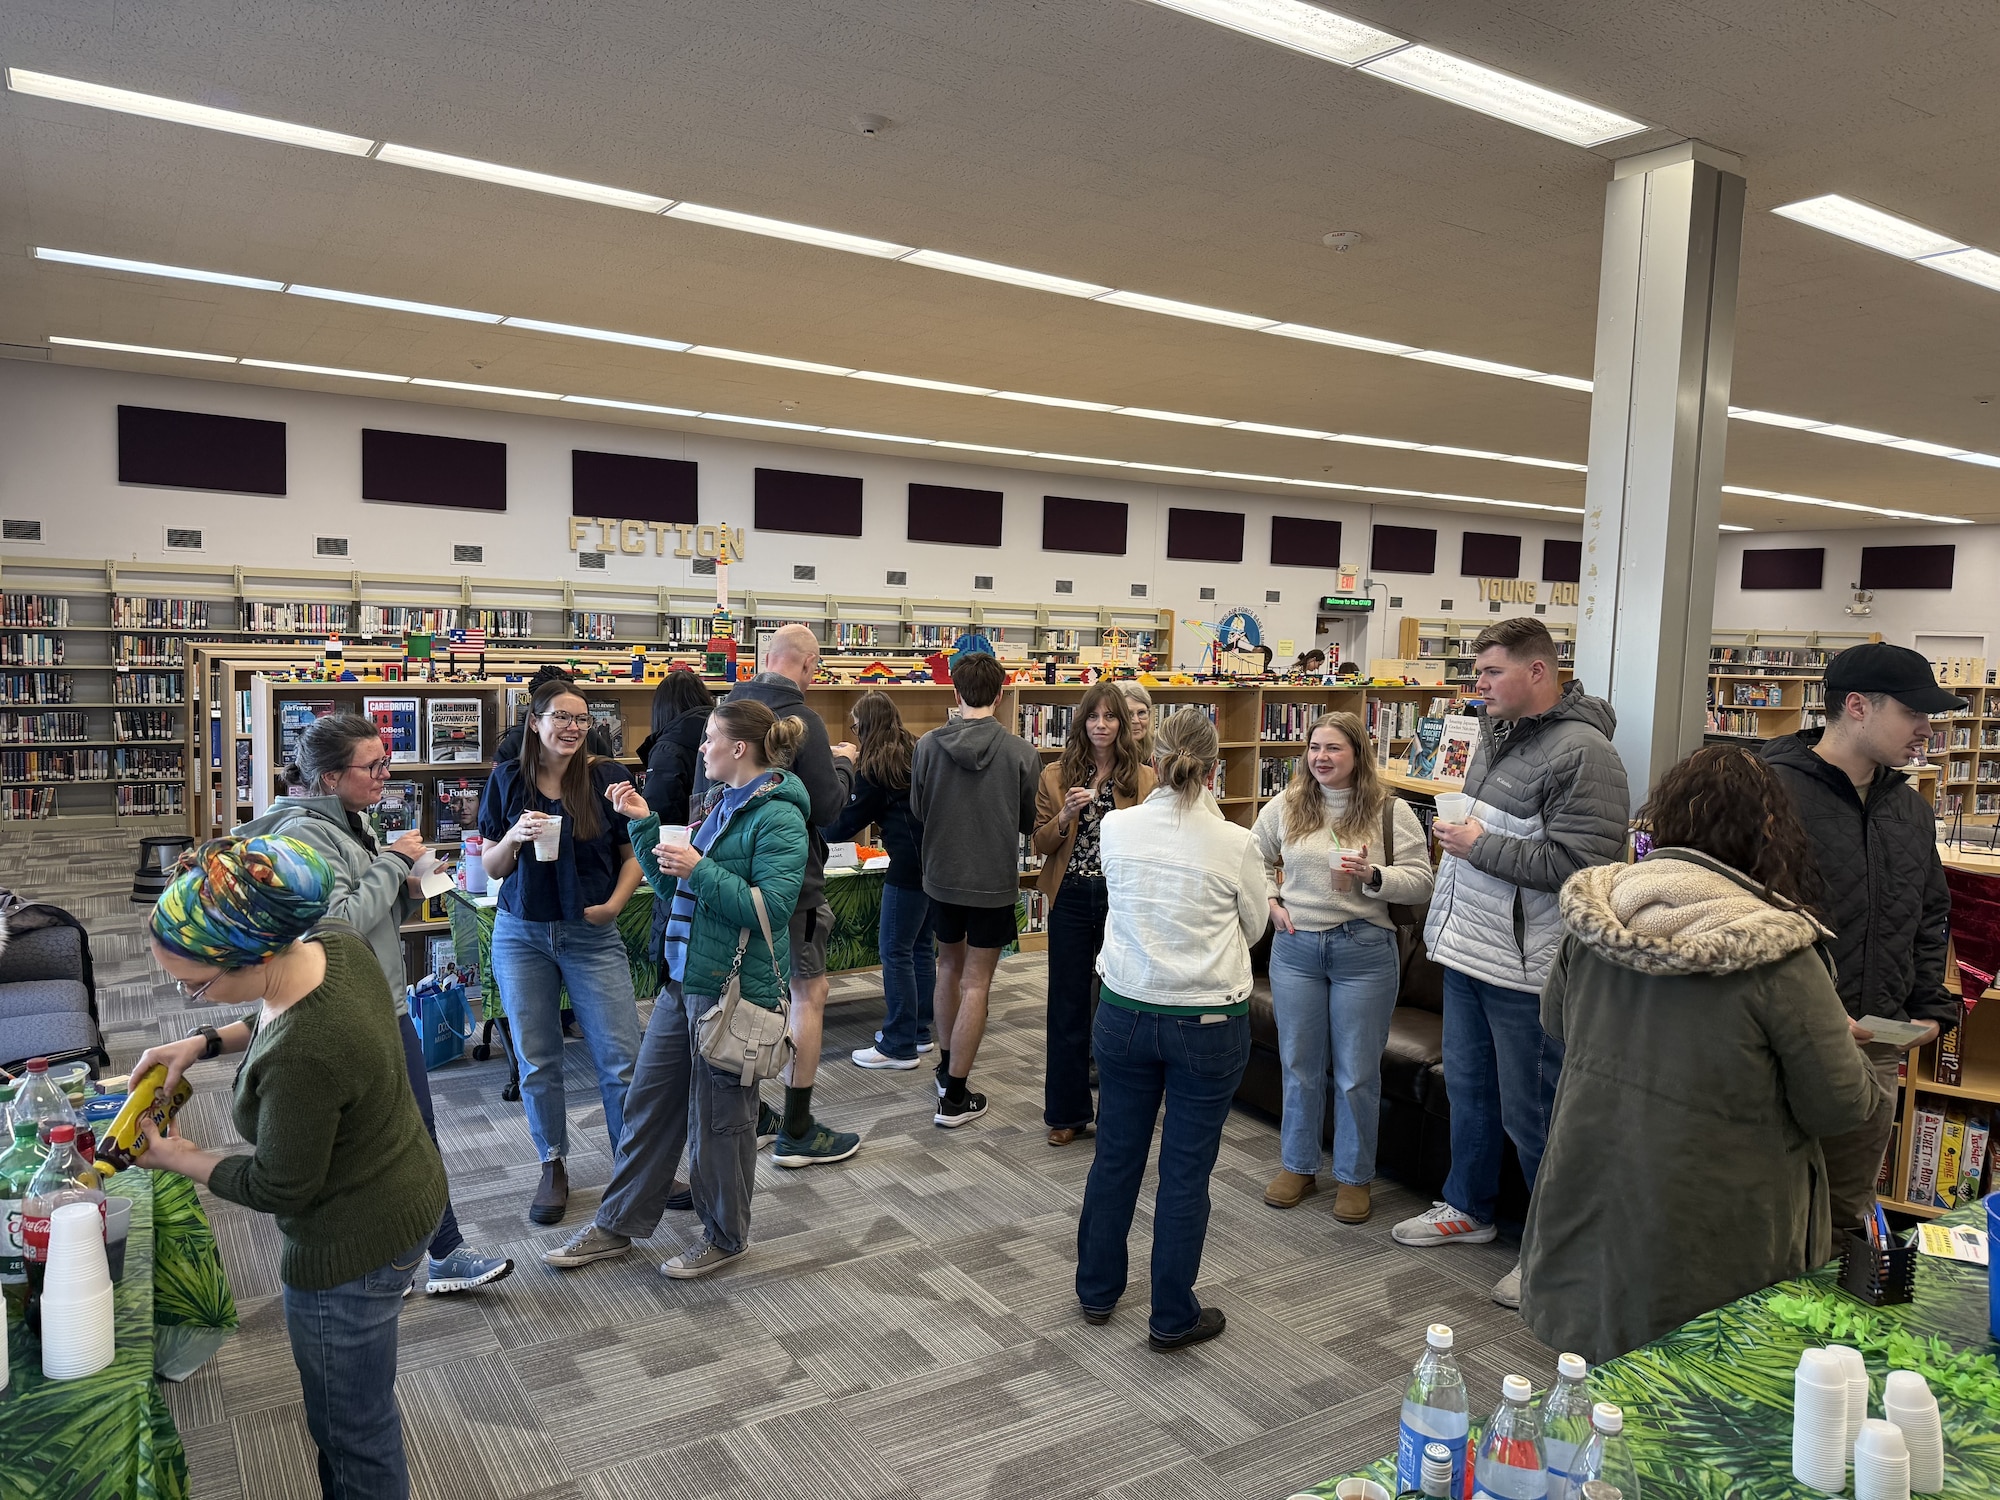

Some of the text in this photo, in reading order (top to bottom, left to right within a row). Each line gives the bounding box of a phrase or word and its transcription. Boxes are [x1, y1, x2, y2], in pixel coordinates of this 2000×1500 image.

[568, 516, 745, 560] FICTION
[1341, 576, 1354, 589] EXIT
[1478, 578, 1579, 606] YOUNG ADU
[1228, 607, 1238, 616] AIR
[1238, 606, 1255, 616] FORCE
[369, 702, 384, 711] CAR
[390, 702, 415, 711] DRIVER
[434, 703, 448, 711] CAR
[453, 703, 477, 712] DRIVER
[379, 726, 405, 734] 10Best
[1423, 722, 1443, 730] MODERN
[381, 786, 405, 795] dyman
[448, 788, 479, 797] Forbes
[1941, 1026, 1960, 1070] ene it?
[1970, 1133, 1983, 1167] Twister
[1918, 1125, 1938, 1189] TICKET TO RIDE
[1944, 1152, 1955, 1180] STRIKE
[9, 1261, 25, 1270] ZER
